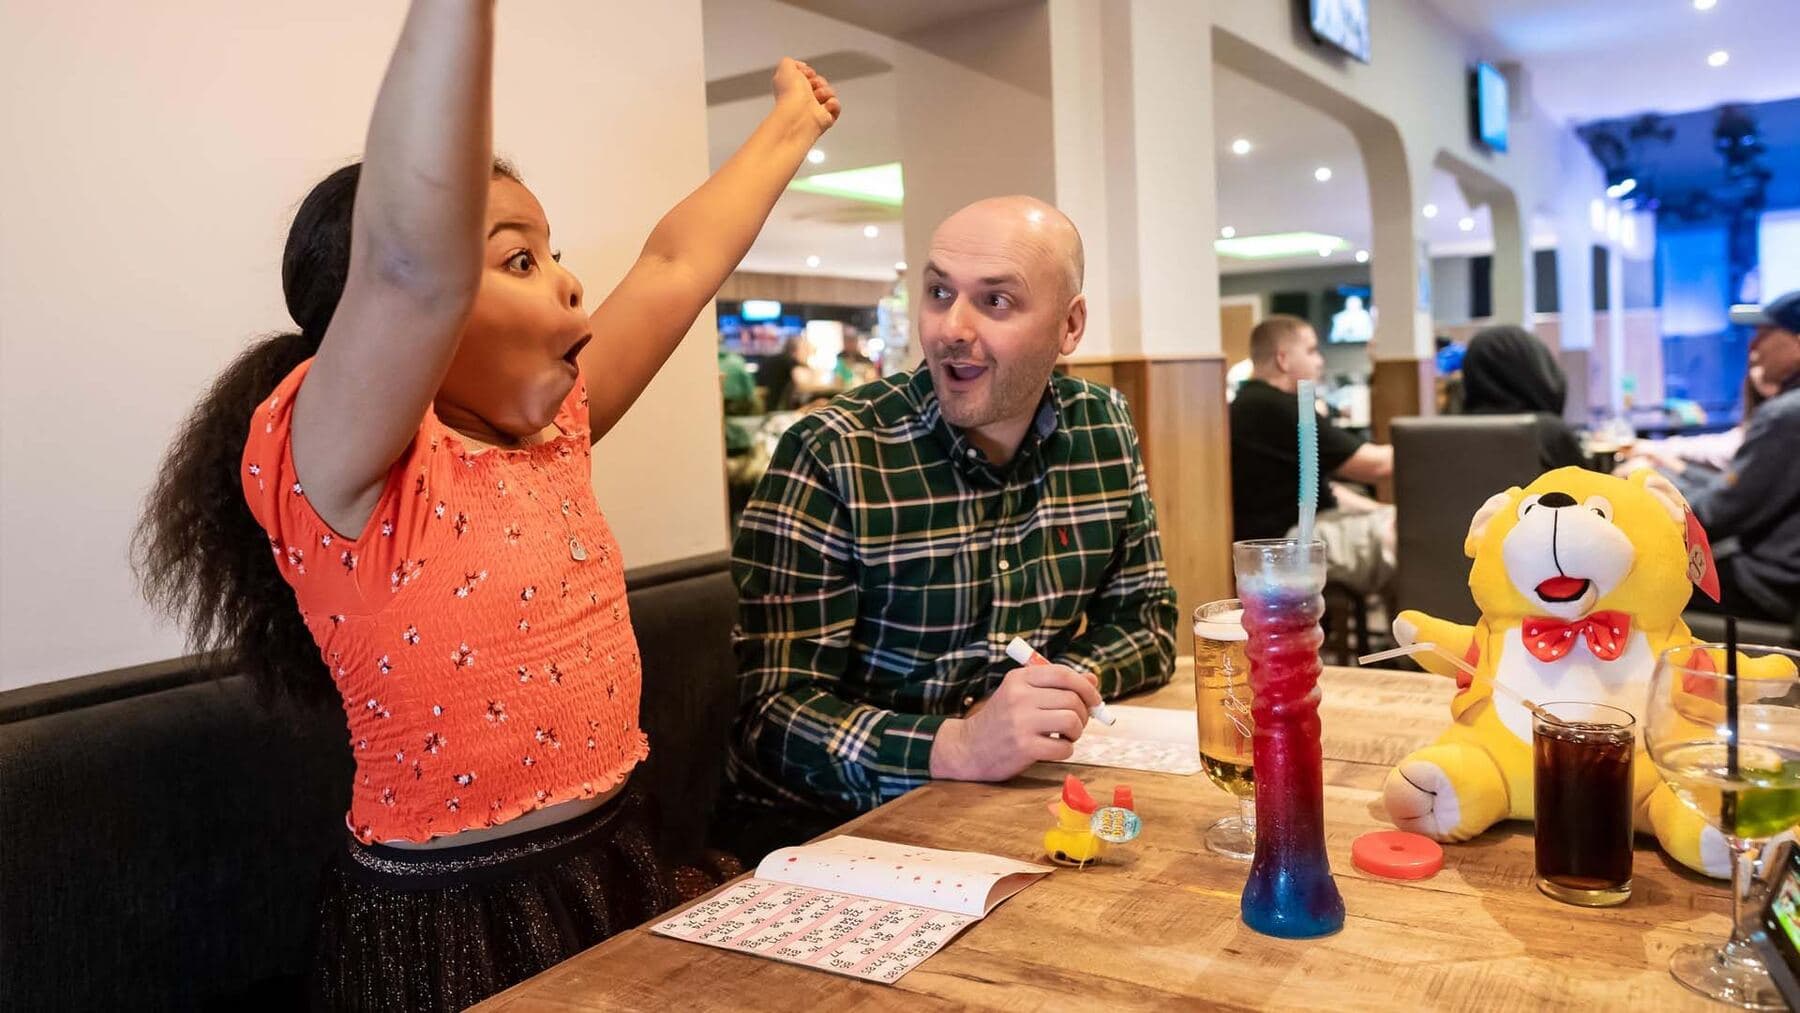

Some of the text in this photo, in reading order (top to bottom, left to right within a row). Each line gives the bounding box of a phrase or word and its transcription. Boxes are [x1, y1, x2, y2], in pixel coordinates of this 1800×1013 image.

[747, 890, 760, 898] 27
[782, 897, 796, 905] 20
[717, 902, 729, 910] 47
[706, 908, 719, 916] 57
[810, 911, 824, 919] 33
[849, 909, 863, 917] 22
[849, 918, 864, 926] 32
[879, 914, 896, 922] 25
[732, 921, 745, 929] 67
[839, 925, 853, 933] 42
[920, 921, 935, 929] 29
[931, 923, 946, 931] 26
[828, 932, 843, 940] 52
[880, 933, 894, 941] 40
[911, 929, 926, 937] 36
[717, 935, 733, 943] 84
[808, 936, 823, 944] 61
[829, 916, 904, 967] 24 41 51 87
[912, 939, 926, 948] 49
[923, 941, 937, 949] 44
[829, 949, 844, 958] 77
[860, 947, 875, 955] 60
[902, 947, 918, 955] 53
[870, 958, 887, 967] 72
[893, 963, 909, 971] 70
